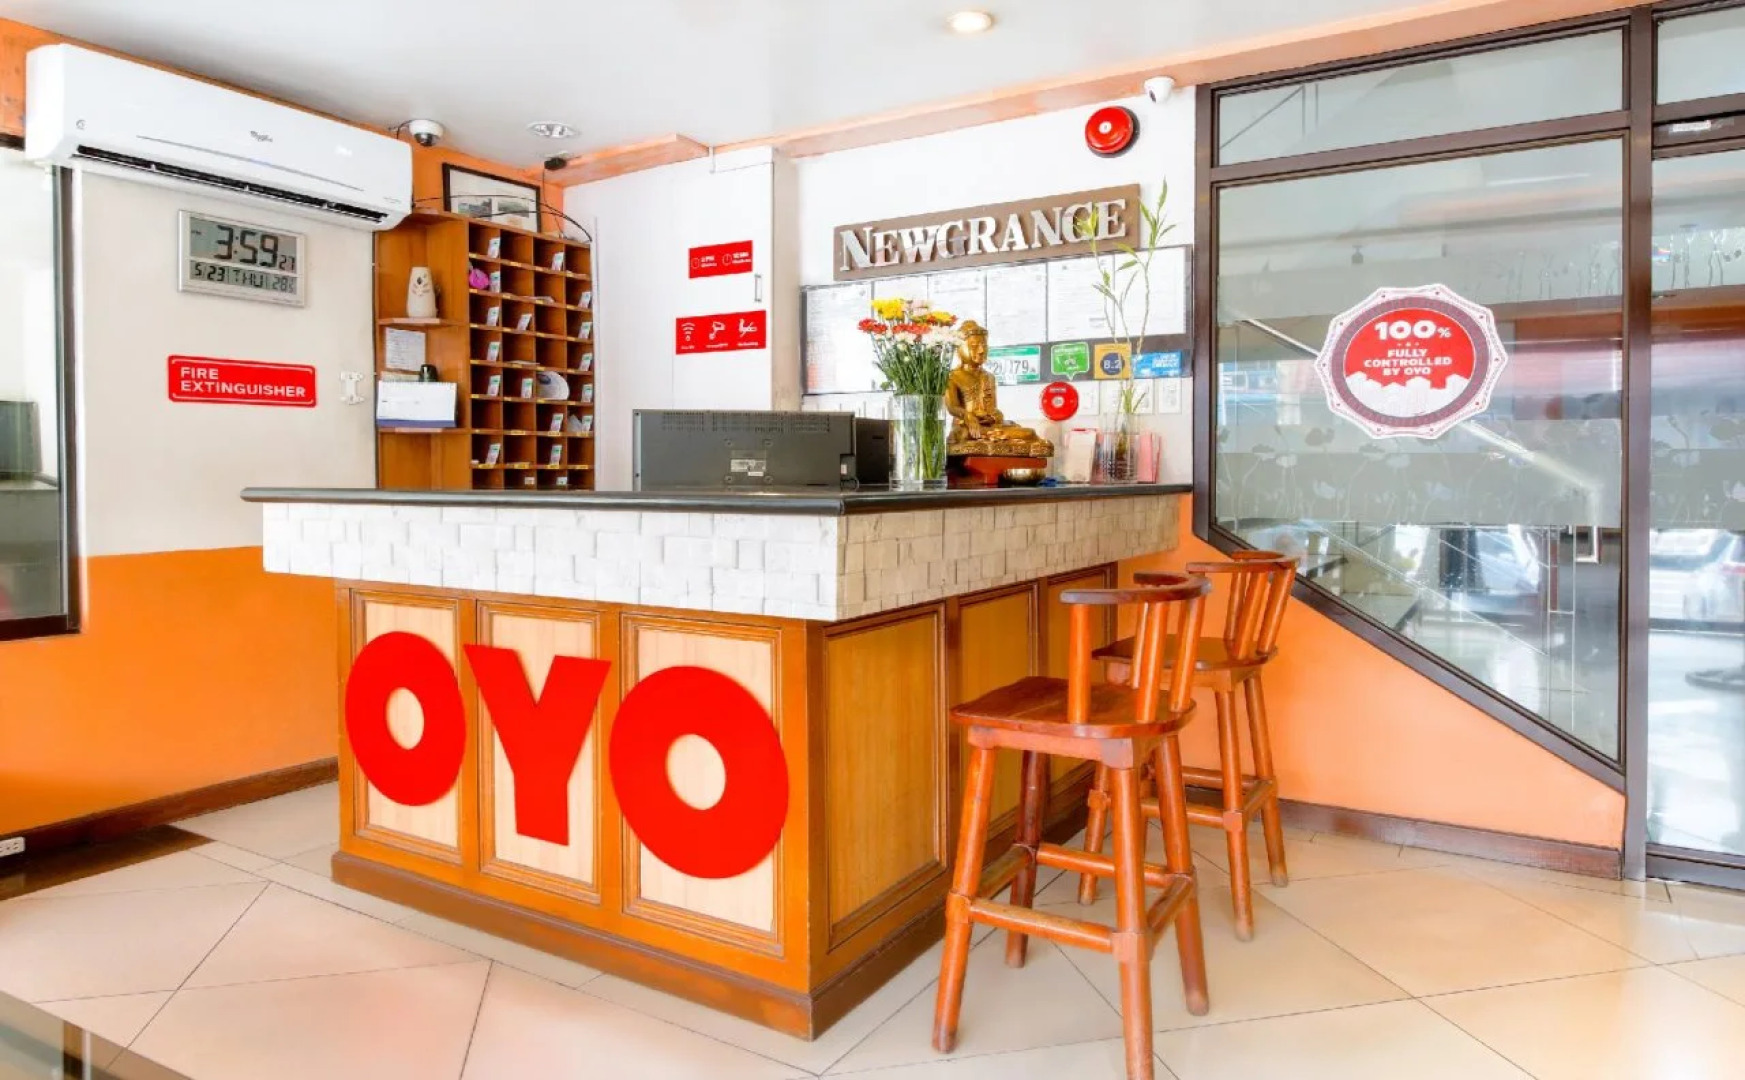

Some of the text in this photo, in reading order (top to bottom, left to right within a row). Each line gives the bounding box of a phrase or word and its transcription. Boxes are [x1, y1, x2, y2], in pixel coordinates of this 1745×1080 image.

[214, 224, 279, 268] 3:59
[232, 269, 264, 289] THU
[1374, 320, 1452, 340] 100%
[1363, 357, 1452, 367] CONTROLLED
[1387, 349, 1428, 357] FULLY
[180, 366, 219, 380] FIRE
[1382, 366, 1432, 376] BY OYO
[180, 380, 306, 398] EXTINGUISHER
[345, 631, 789, 879] OYO
